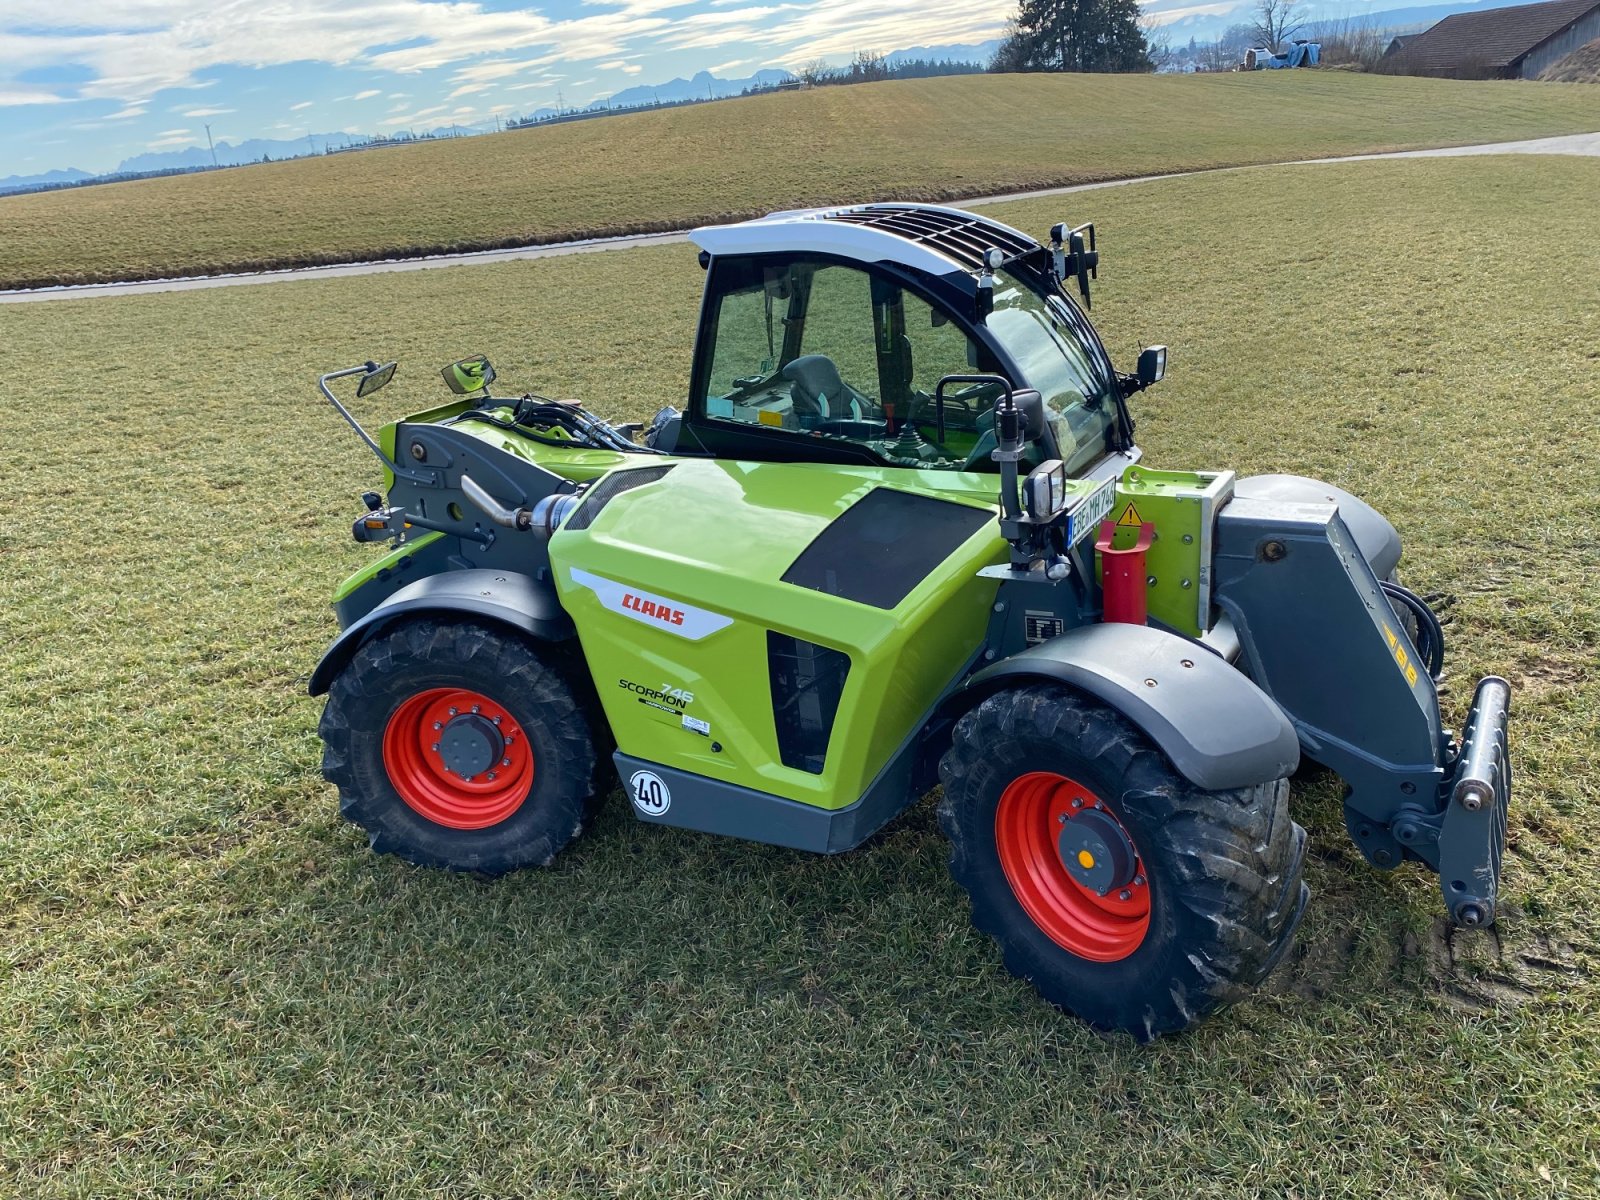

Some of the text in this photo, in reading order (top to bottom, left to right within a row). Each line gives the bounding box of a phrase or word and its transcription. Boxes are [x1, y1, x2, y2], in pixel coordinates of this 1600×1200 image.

[622, 593, 685, 626] CLAAS
[618, 679, 687, 709] SCORPION
[660, 683, 694, 704] 746
[638, 778, 662, 808] 40
